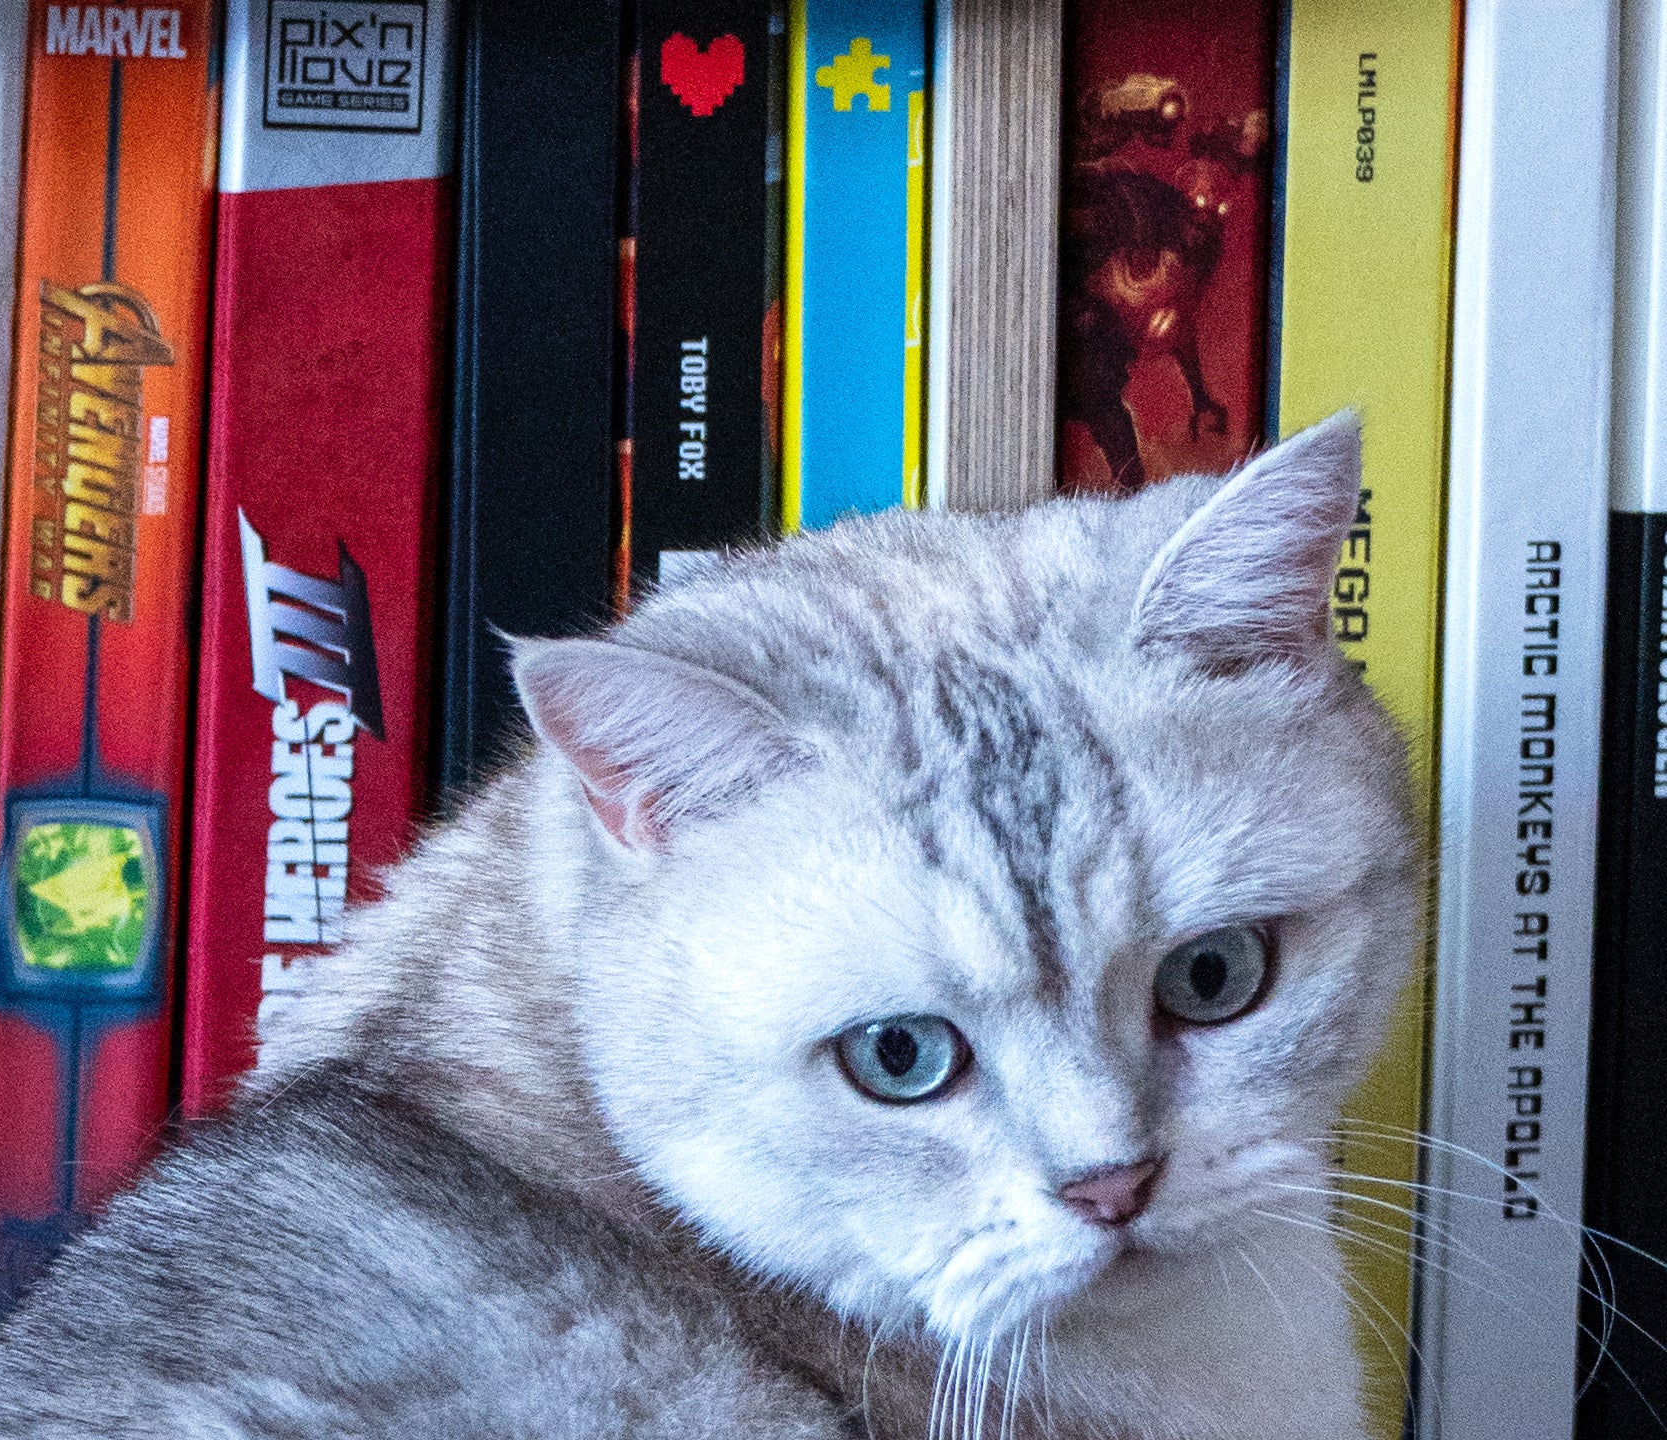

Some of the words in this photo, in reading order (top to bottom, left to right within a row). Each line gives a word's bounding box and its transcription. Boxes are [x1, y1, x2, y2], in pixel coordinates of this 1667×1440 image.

[45, 6, 187, 59] MARVEL
[279, 9, 414, 53] pix'n
[1356, 51, 1380, 184] LMLP039
[34, 315, 63, 496] INFINITY
[678, 337, 712, 411] TOBY
[40, 278, 174, 625] AVENGERS
[676, 422, 708, 481] FOX
[30, 518, 56, 600] WAR
[1523, 540, 1561, 677] ARCTIC
[263, 701, 361, 945] HEROES
[1514, 692, 1558, 899] MONKEYS
[1511, 912, 1551, 959] AT
[1507, 975, 1549, 1052] THE
[1501, 1067, 1544, 1223] APOLLO
